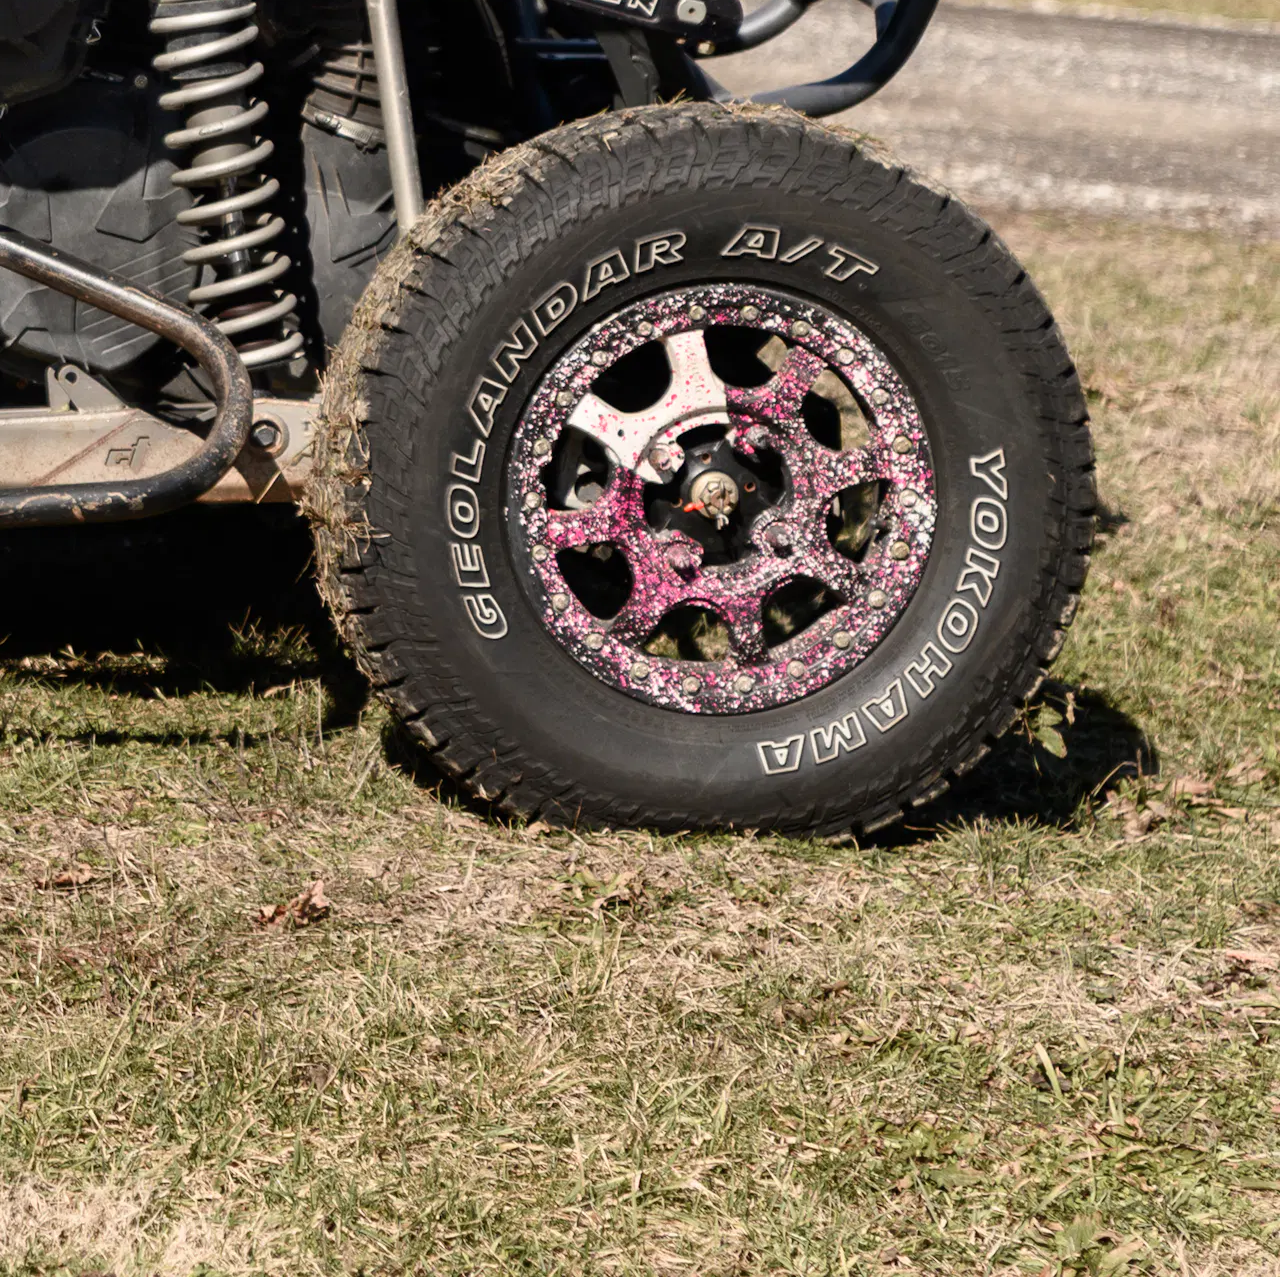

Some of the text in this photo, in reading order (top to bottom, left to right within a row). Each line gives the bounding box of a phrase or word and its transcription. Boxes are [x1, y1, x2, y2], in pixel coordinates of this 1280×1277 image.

[447, 224, 880, 640] GEOLANDAR A/T
[757, 448, 1009, 776] YOKOHAMA
